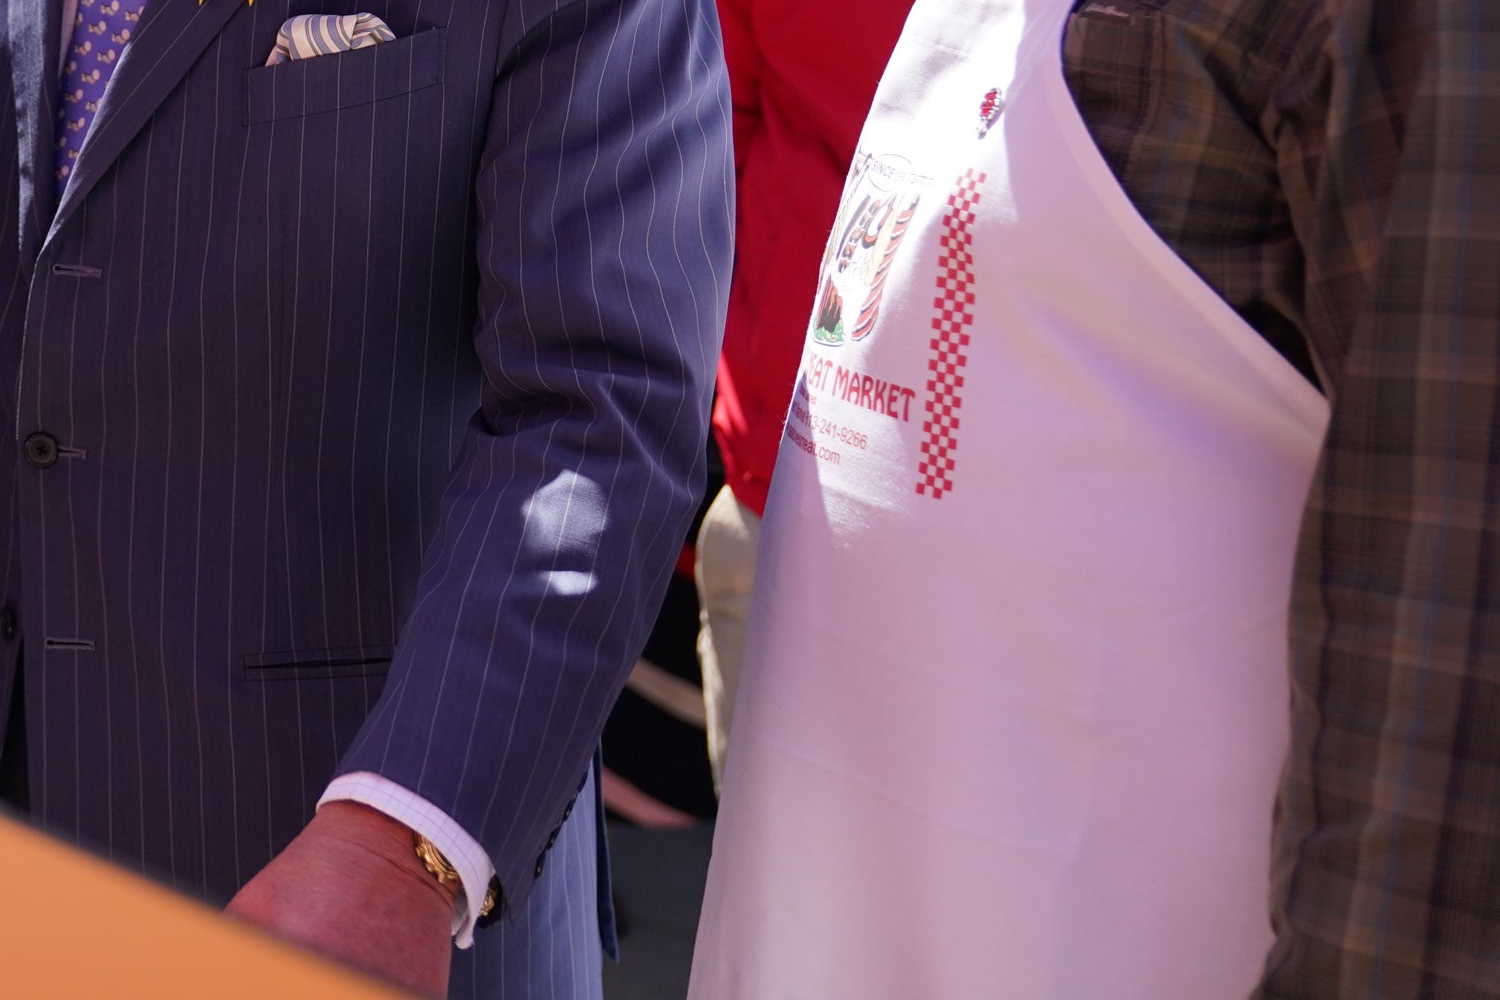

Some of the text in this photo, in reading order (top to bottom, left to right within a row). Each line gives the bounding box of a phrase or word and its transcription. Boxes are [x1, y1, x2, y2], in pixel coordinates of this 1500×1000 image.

[870, 160, 896, 179] SINCE
[805, 350, 834, 392] EAT
[832, 365, 916, 422] MARKET
